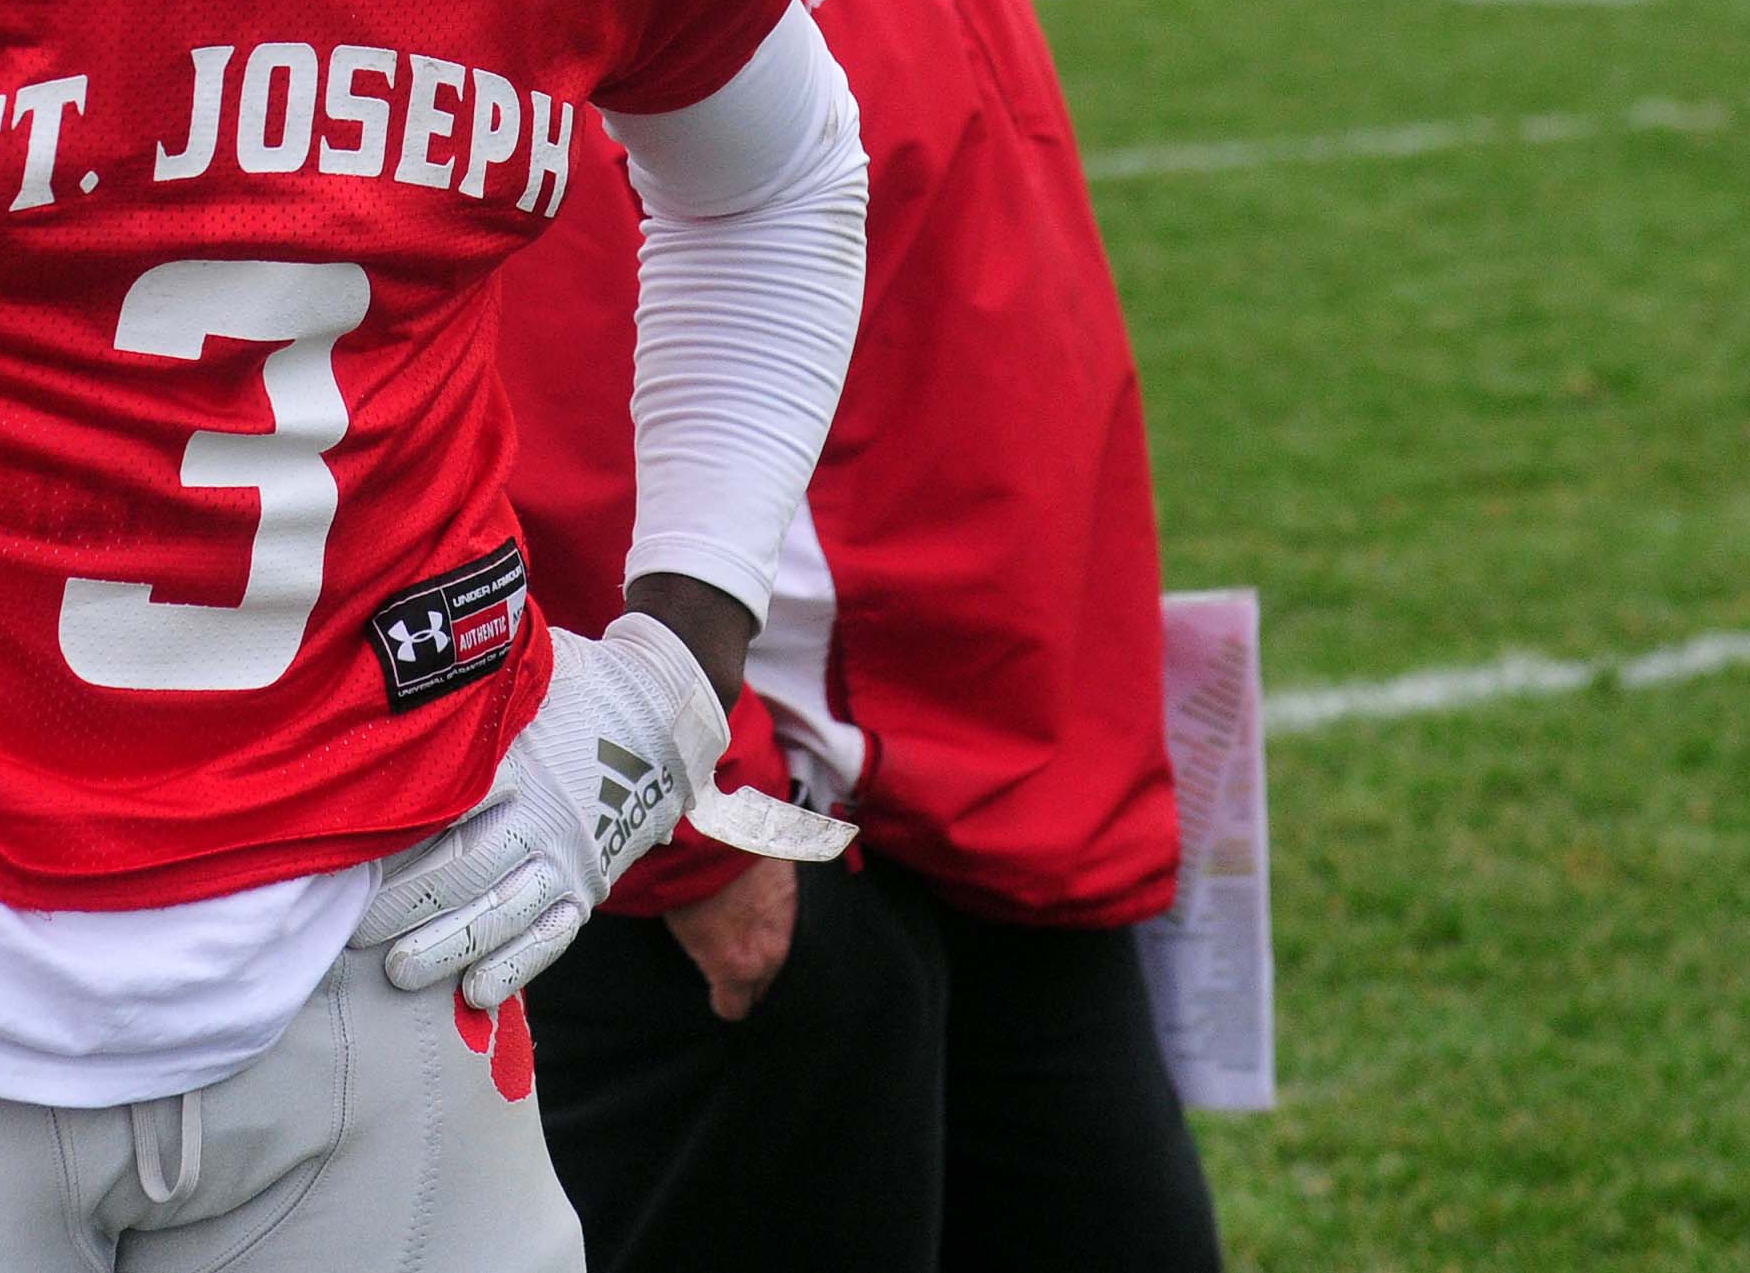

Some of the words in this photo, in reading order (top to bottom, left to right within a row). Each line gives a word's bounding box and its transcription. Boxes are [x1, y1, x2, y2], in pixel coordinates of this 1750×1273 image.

[153, 43, 574, 218] JOSEPH
[58, 260, 371, 690] 3
[452, 584, 491, 608] UNDER
[459, 614, 508, 652] AUTHENTIC
[600, 766, 674, 877] adidas
